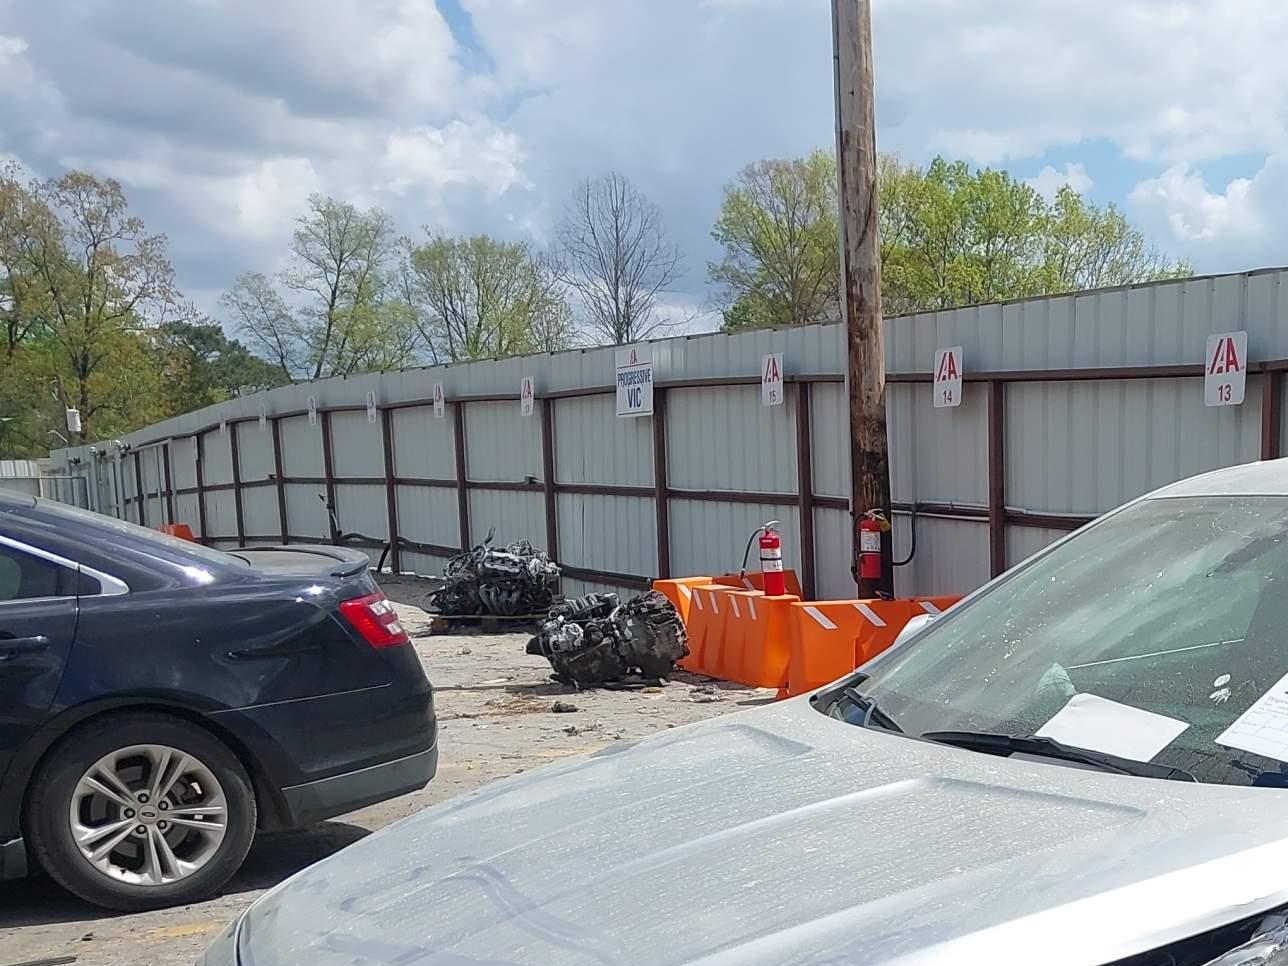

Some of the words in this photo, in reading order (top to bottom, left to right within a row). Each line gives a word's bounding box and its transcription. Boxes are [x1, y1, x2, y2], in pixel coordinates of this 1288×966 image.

[617, 368, 651, 388] PROGRESSIVE
[627, 386, 642, 409] VIC
[769, 390, 777, 403] 15
[943, 390, 953, 404] 14
[1218, 384, 1232, 402] 13
